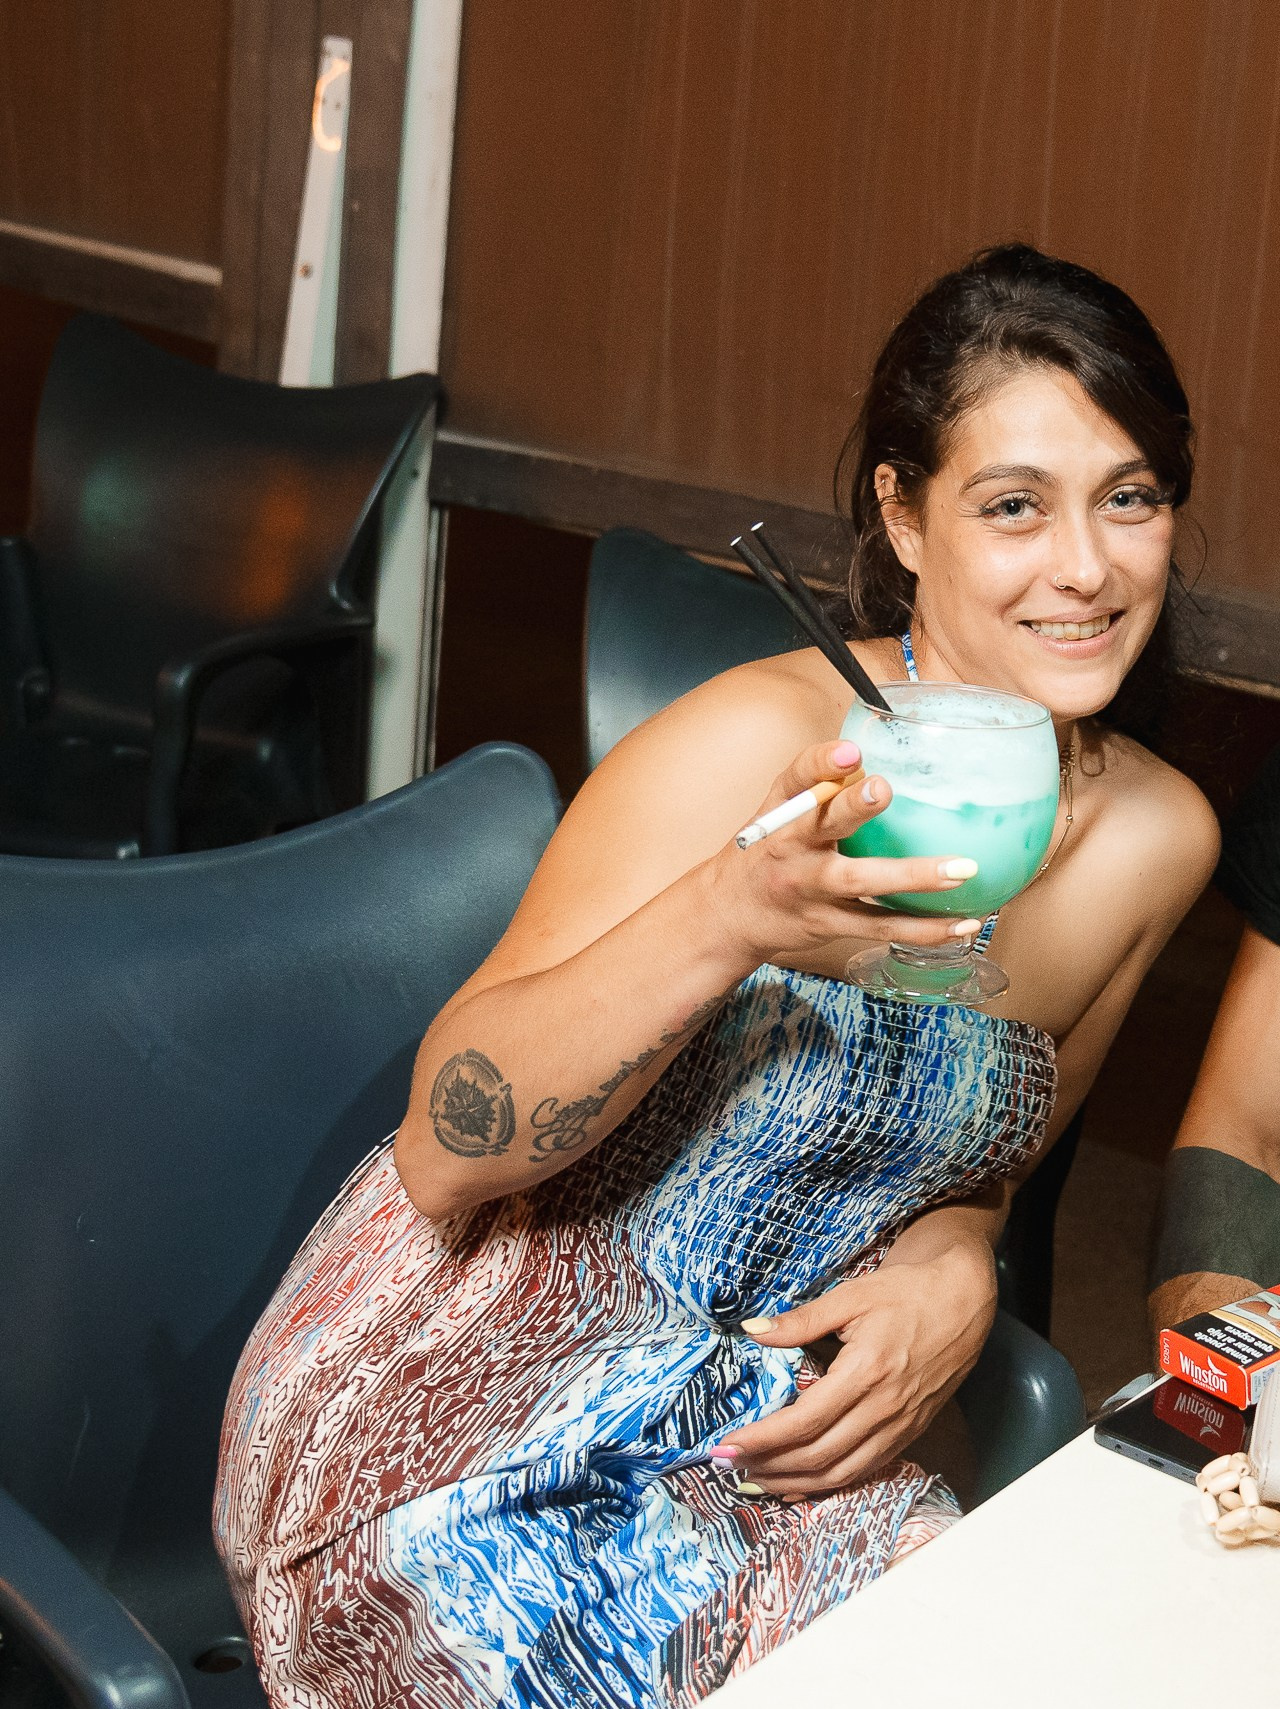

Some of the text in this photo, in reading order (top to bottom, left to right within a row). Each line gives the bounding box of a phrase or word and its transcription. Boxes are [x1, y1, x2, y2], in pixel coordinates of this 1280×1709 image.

[1194, 1331, 1226, 1348] puede
[1206, 1327, 1226, 1340] hijo
[1224, 1325, 1255, 1343] espera
[1232, 1341, 1263, 1358] matar
[1253, 1340, 1274, 1352] que
[1221, 1346, 1253, 1364] Fumar
[1179, 1350, 1228, 1394] Winston
